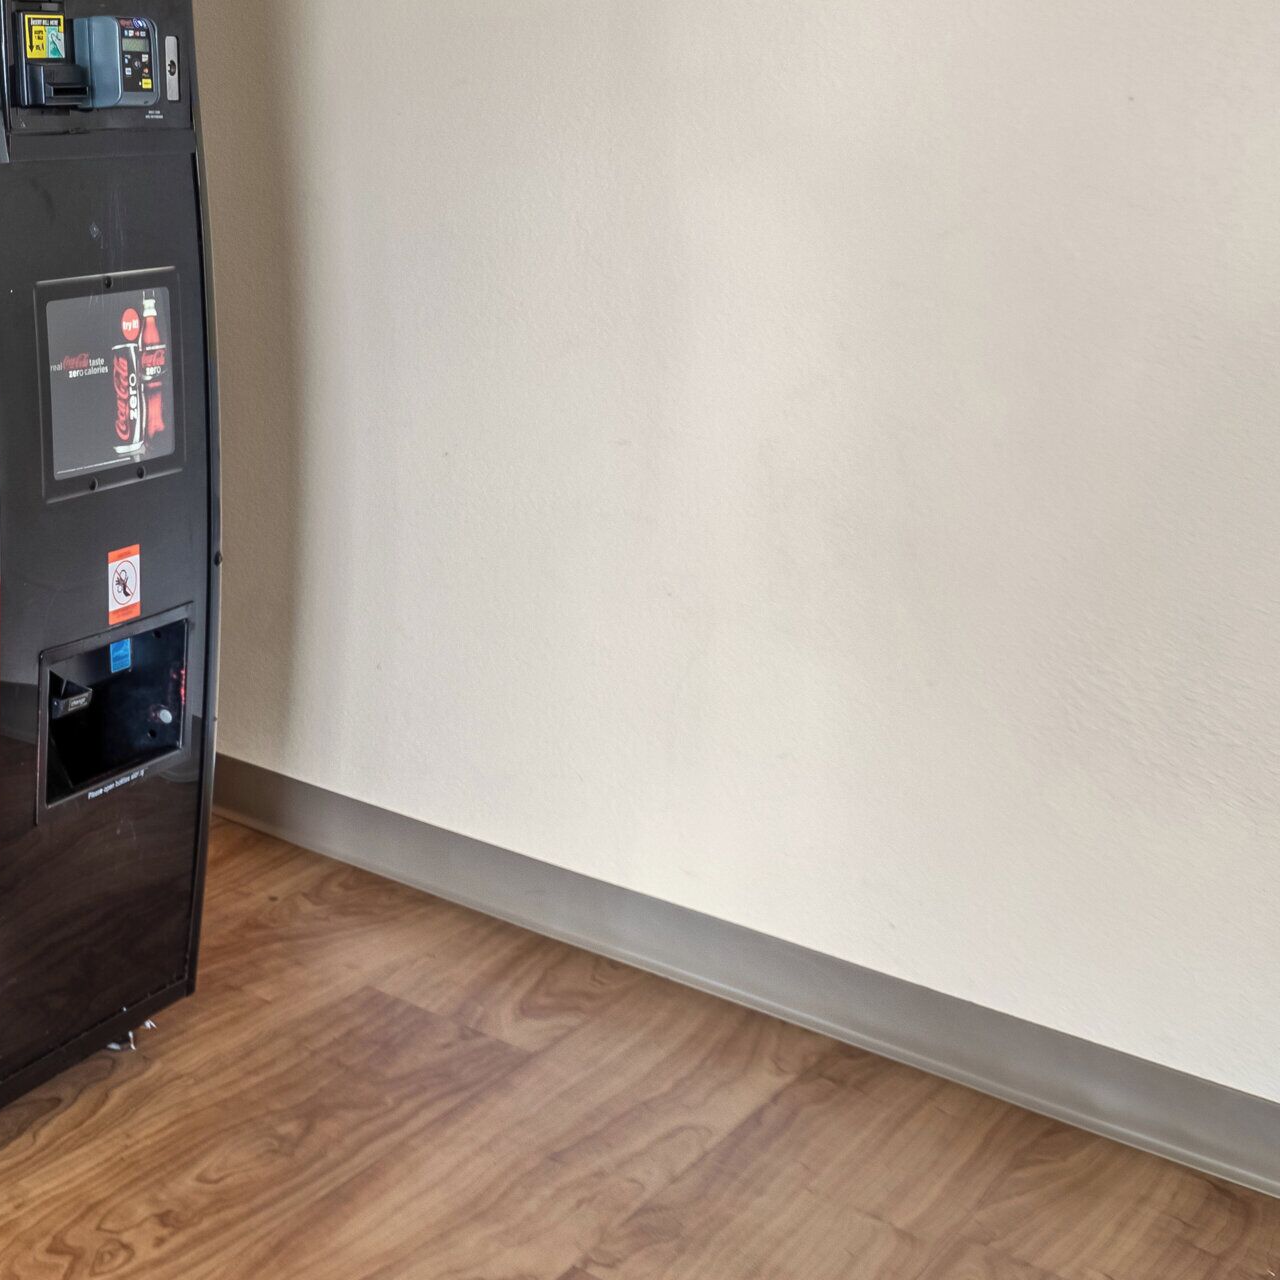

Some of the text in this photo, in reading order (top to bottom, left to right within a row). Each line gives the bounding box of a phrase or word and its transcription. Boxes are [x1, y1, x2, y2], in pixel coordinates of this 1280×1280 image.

[89, 358, 104, 366] taste
[146, 366, 161, 375] zero
[129, 373, 137, 420] zero
